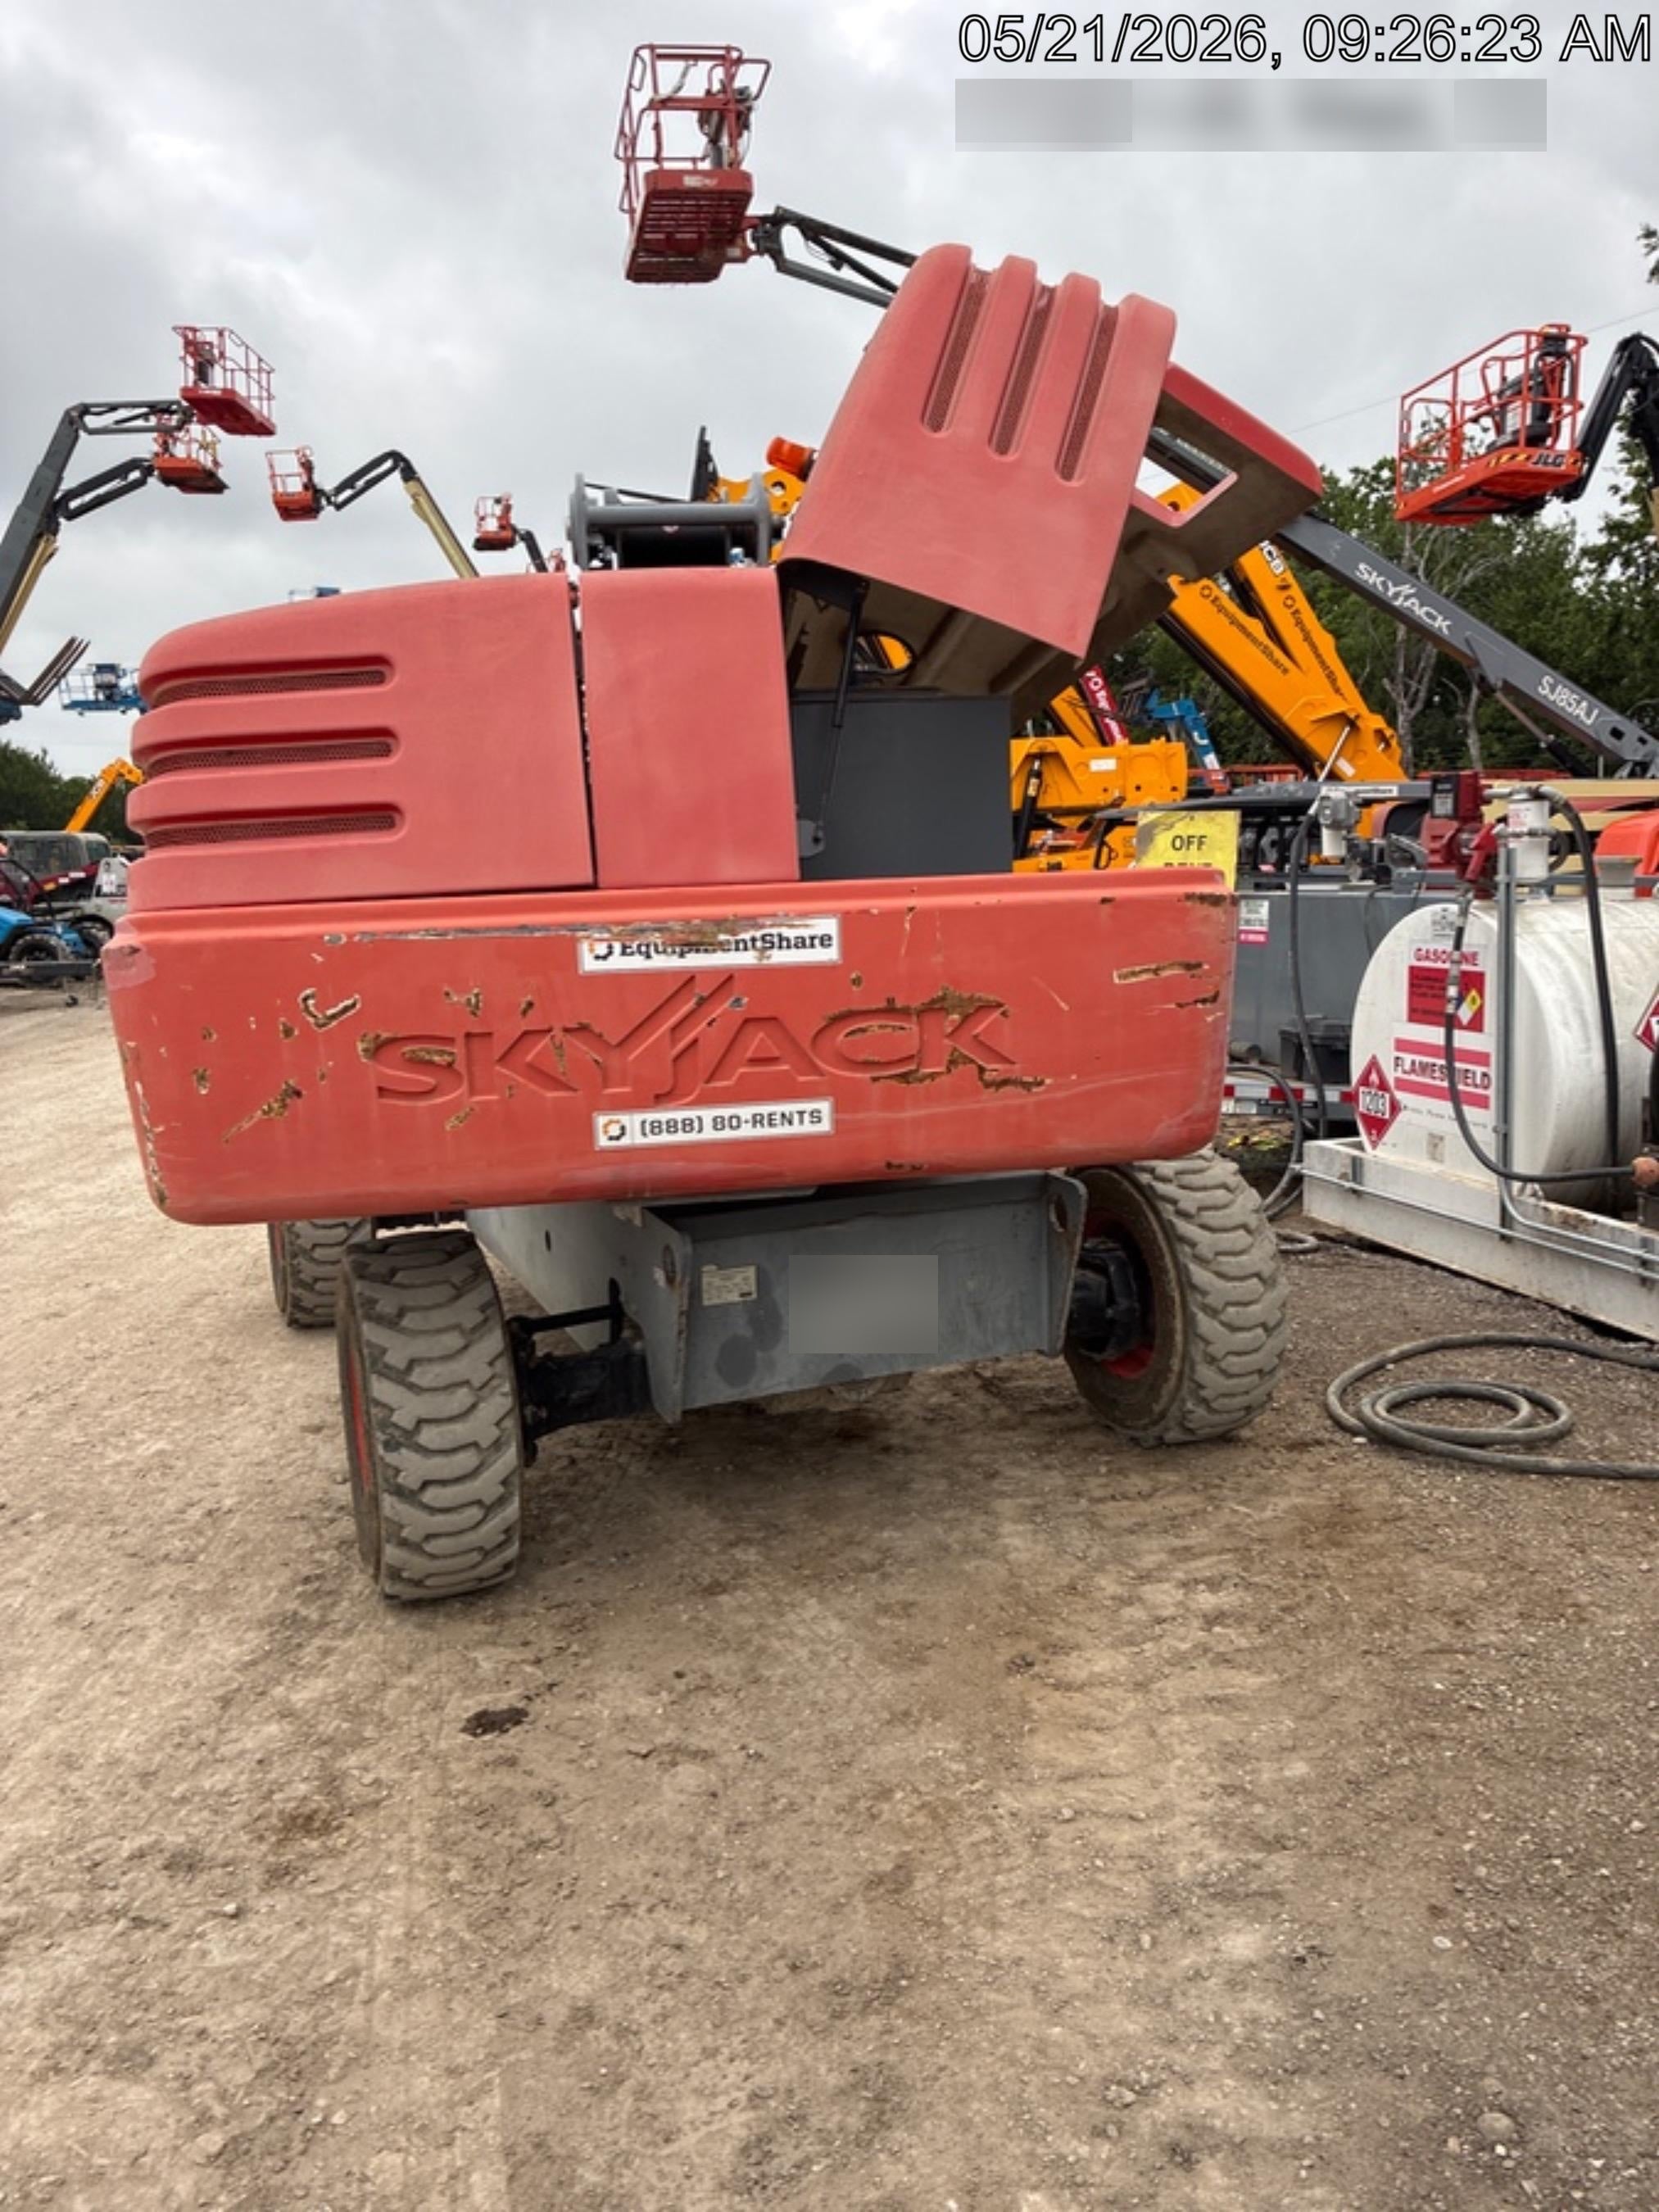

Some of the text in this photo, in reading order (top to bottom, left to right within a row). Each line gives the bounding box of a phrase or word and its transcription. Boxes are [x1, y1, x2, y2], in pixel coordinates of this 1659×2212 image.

[1354, 561, 1453, 636] SKYJACK
[1537, 674, 1599, 726] SJ85AJ
[1171, 834, 1208, 851] OFF
[371, 973, 1018, 1106] SKYJACK
[641, 1108, 823, 1136] (888) 80-RENTS
